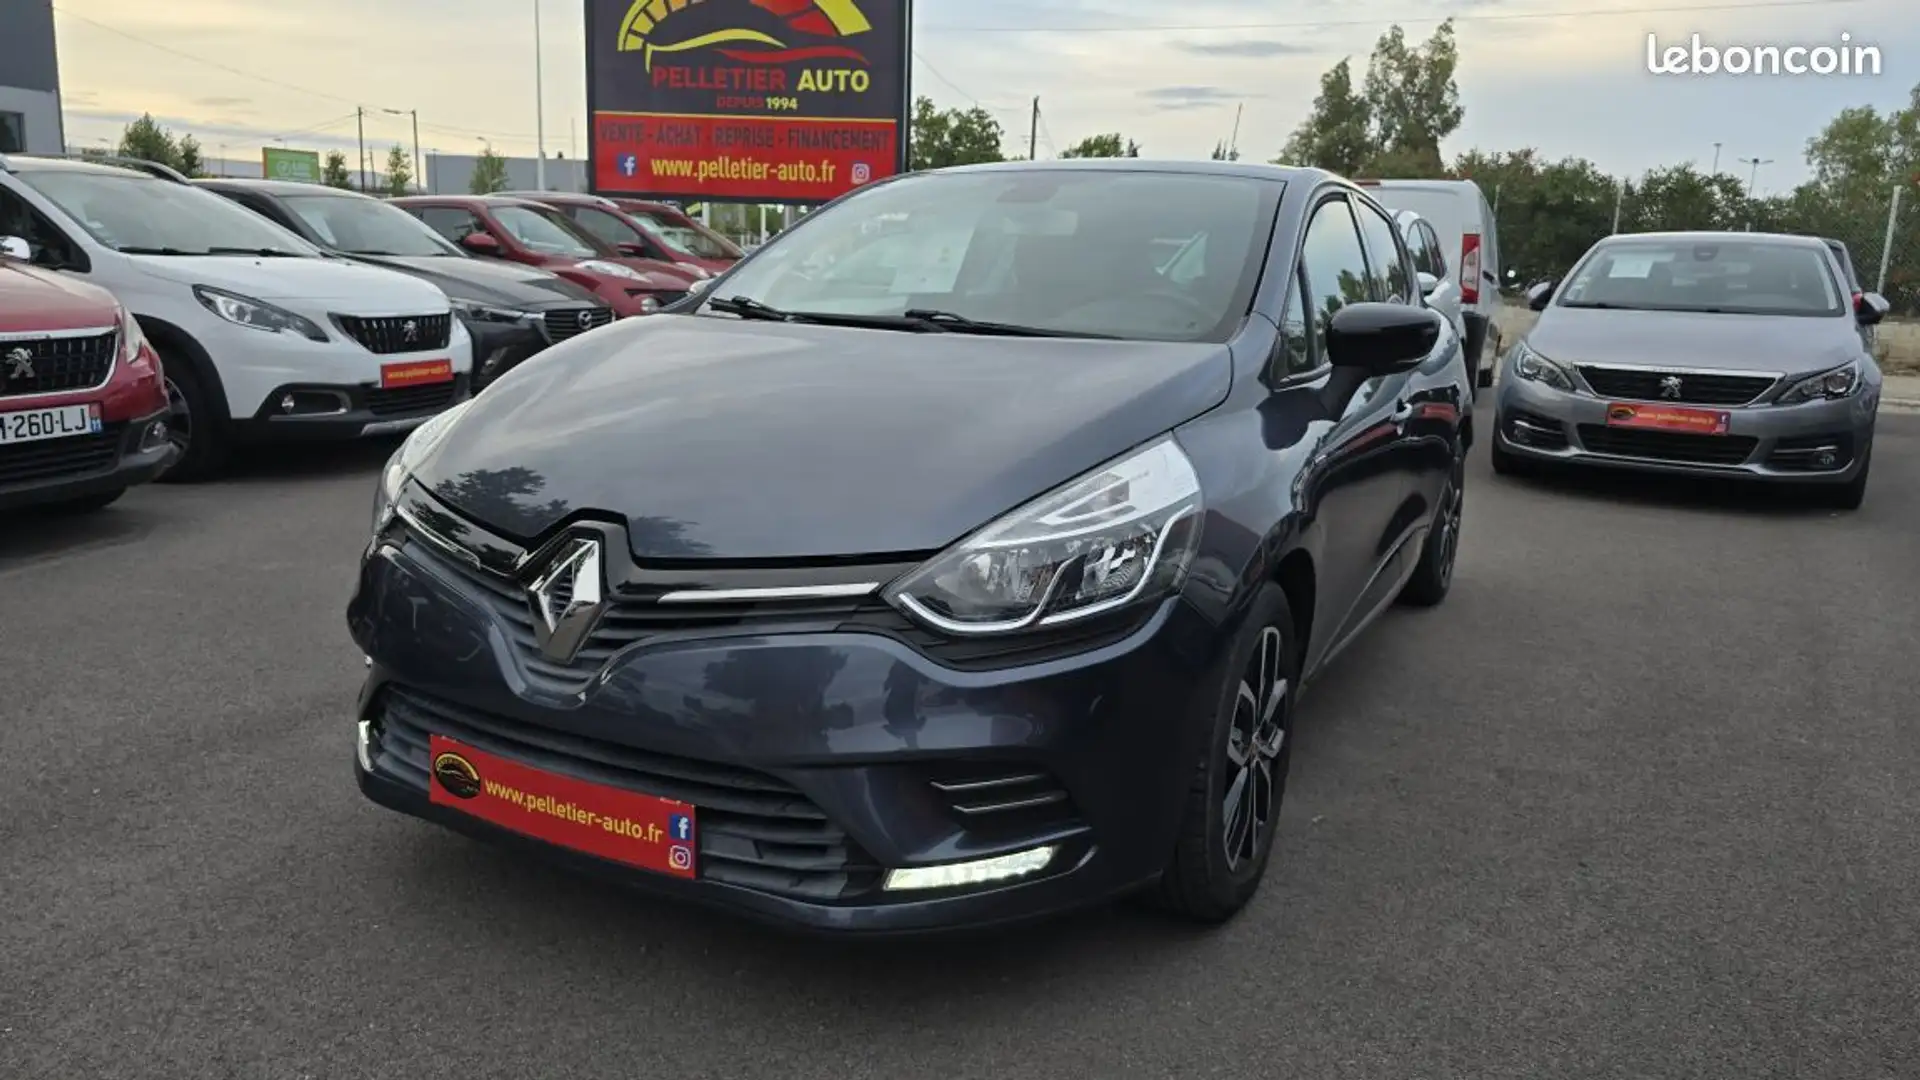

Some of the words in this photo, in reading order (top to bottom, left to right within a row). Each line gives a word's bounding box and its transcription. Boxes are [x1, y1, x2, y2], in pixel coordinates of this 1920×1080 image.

[653, 66, 786, 91] PELLETIER
[797, 69, 869, 92] AUTO
[716, 95, 764, 109] DEPUIS
[765, 97, 798, 110] 1994
[601, 121, 645, 144] VENTE
[655, 123, 702, 146] ACHAT
[713, 126, 775, 149] REPRISE
[788, 127, 890, 151] FINANCEMENT
[651, 156, 836, 183] www.pelletier-auto.fr
[485, 779, 664, 844] www.pelletier-auto.fr
